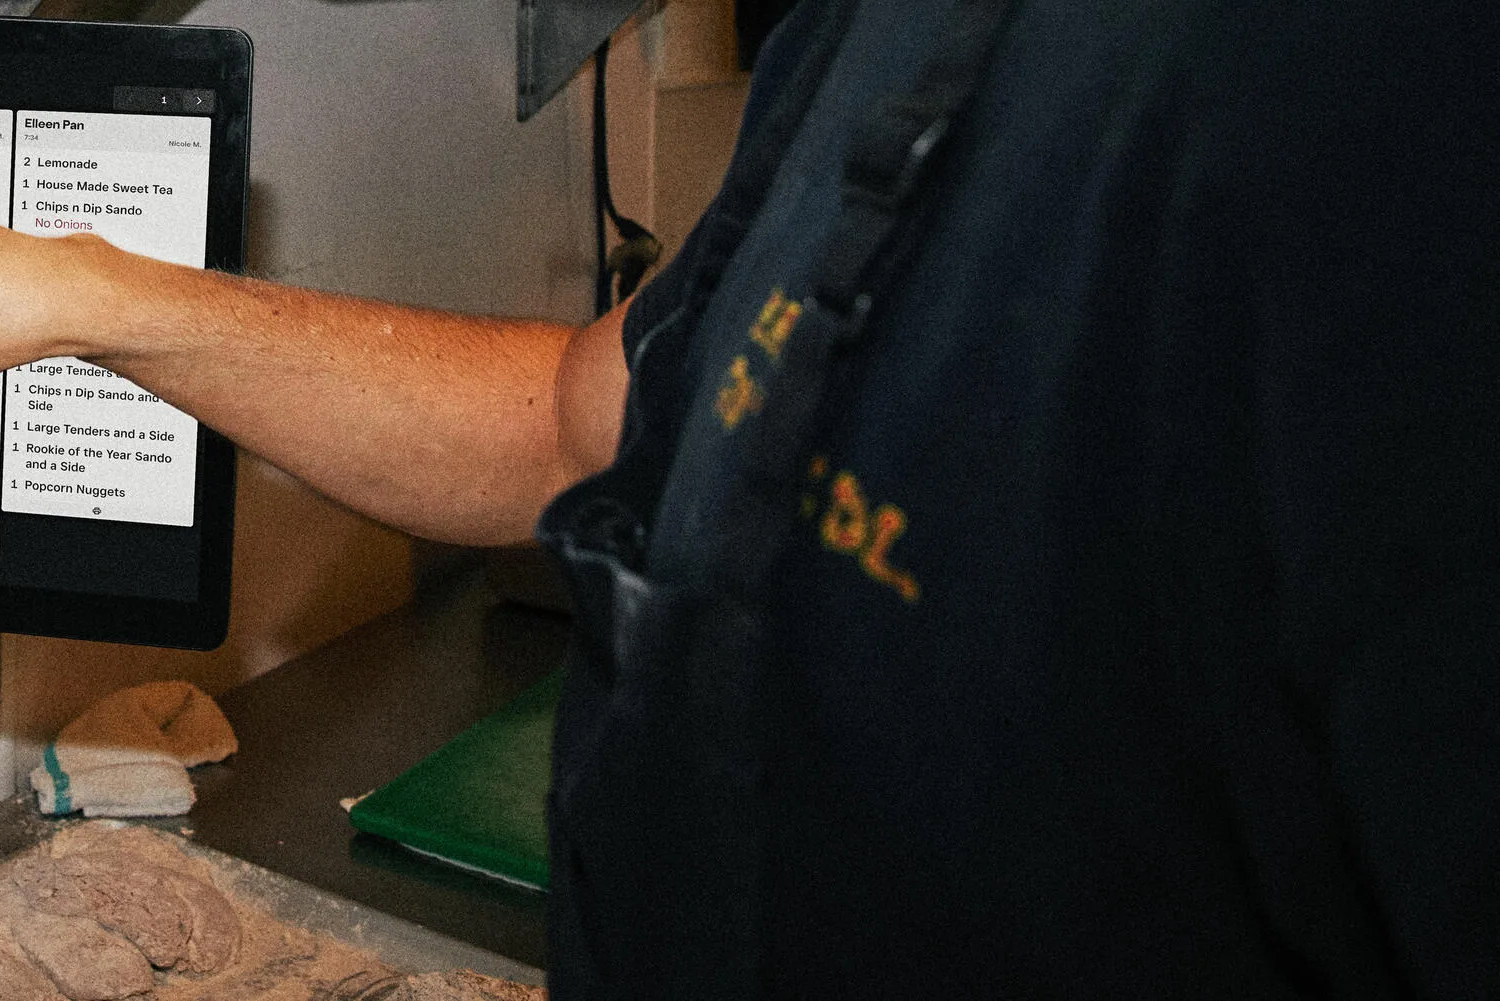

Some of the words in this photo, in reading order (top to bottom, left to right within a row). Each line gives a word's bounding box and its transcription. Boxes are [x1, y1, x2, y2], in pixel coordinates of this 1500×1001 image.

[161, 95, 167, 104] 1
[62, 119, 84, 130] Pan
[36, 178, 73, 190] House
[76, 180, 109, 192] Made
[112, 182, 149, 194] Sweet
[151, 184, 173, 195] Tea
[34, 217, 51, 228] No
[53, 218, 93, 230] Onions
[26, 421, 60, 435] Large
[62, 423, 110, 437] Tenders
[112, 428, 135, 439] and
[137, 431, 145, 439] a
[148, 429, 175, 442] Side
[24, 479, 73, 493] Popcorn
[75, 483, 125, 498] Nuggets
